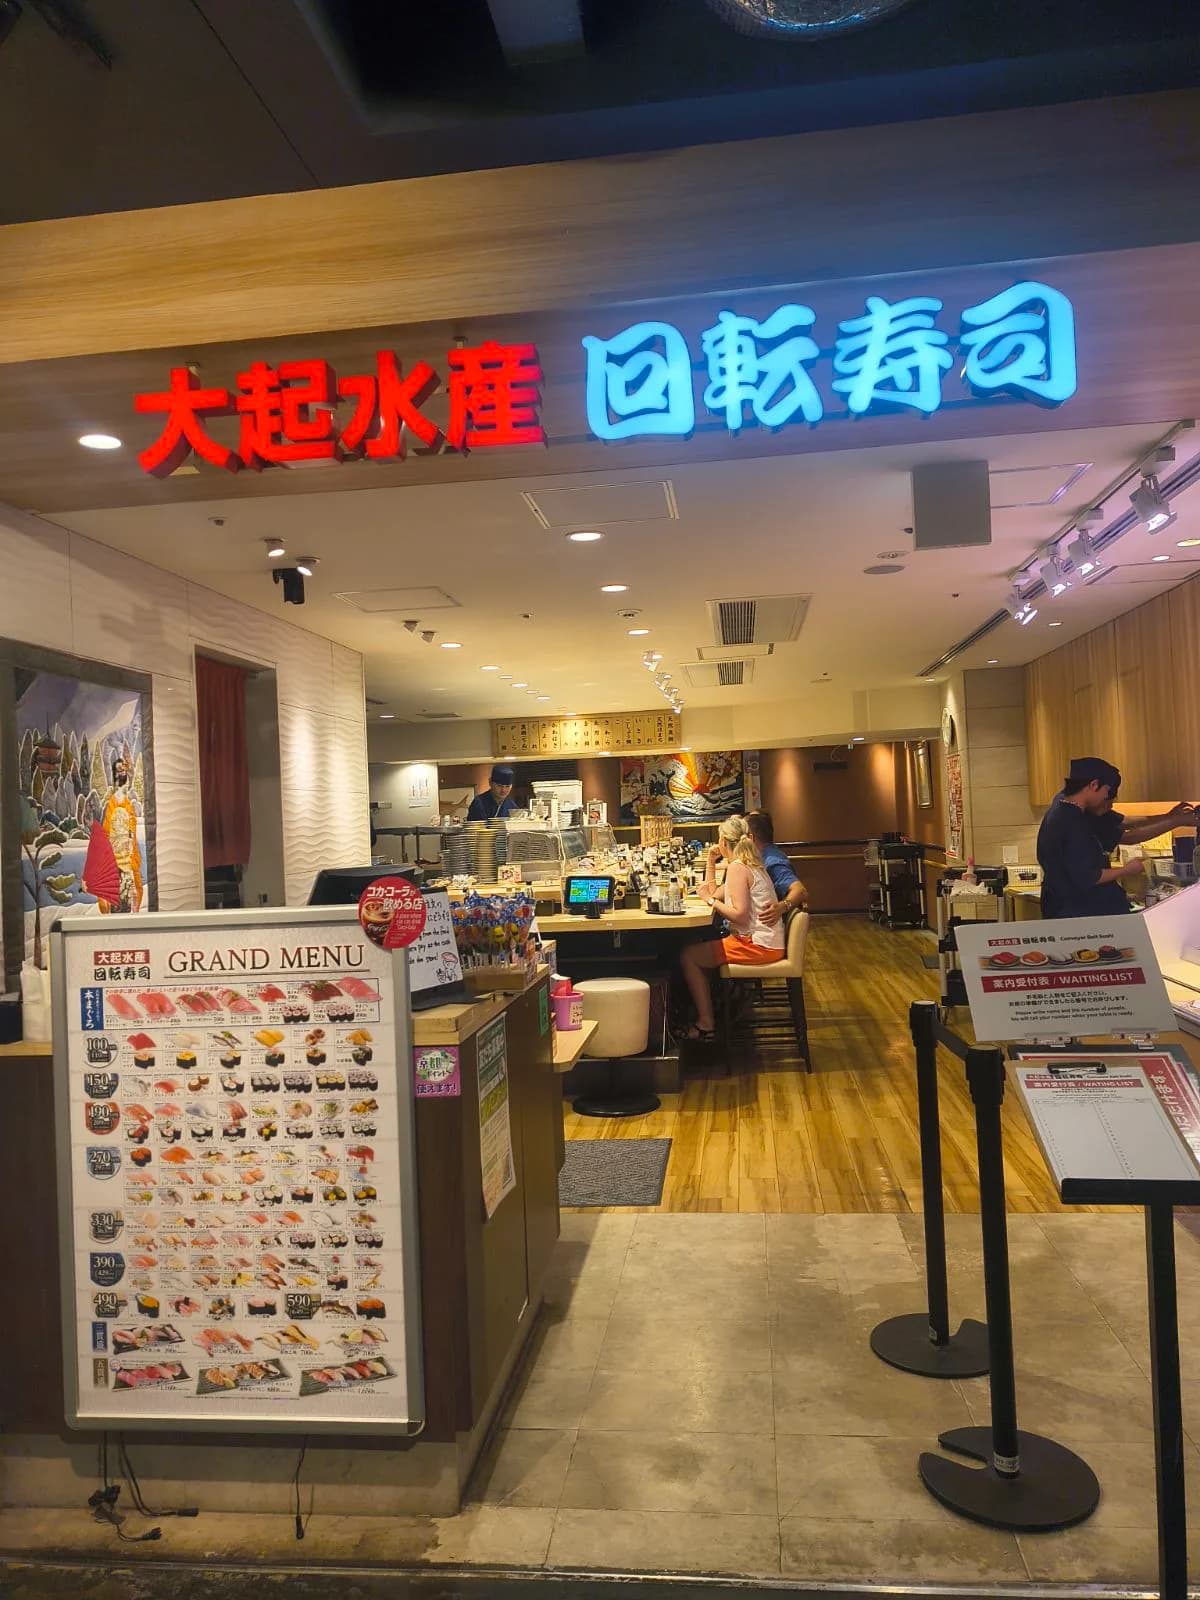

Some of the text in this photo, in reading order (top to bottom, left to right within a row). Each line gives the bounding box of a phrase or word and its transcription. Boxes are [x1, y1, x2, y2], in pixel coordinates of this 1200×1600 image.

[136, 282, 1077, 476] 大起水産 回転寿司
[383, 898, 423, 910] 飲める店
[98, 952, 146, 964] 大起水産
[168, 944, 364, 972] GRAND MENU
[94, 966, 150, 981] 回転寿司
[1059, 974, 1108, 984] WAITING
[1110, 972, 1134, 982] LIST
[84, 990, 94, 1028] 本まぐろ
[420, 1056, 440, 1069] 京都
[90, 1150, 111, 1163] 270
[94, 1256, 114, 1268] 390
[94, 1294, 116, 1305] 490
[288, 1294, 310, 1306] 590
